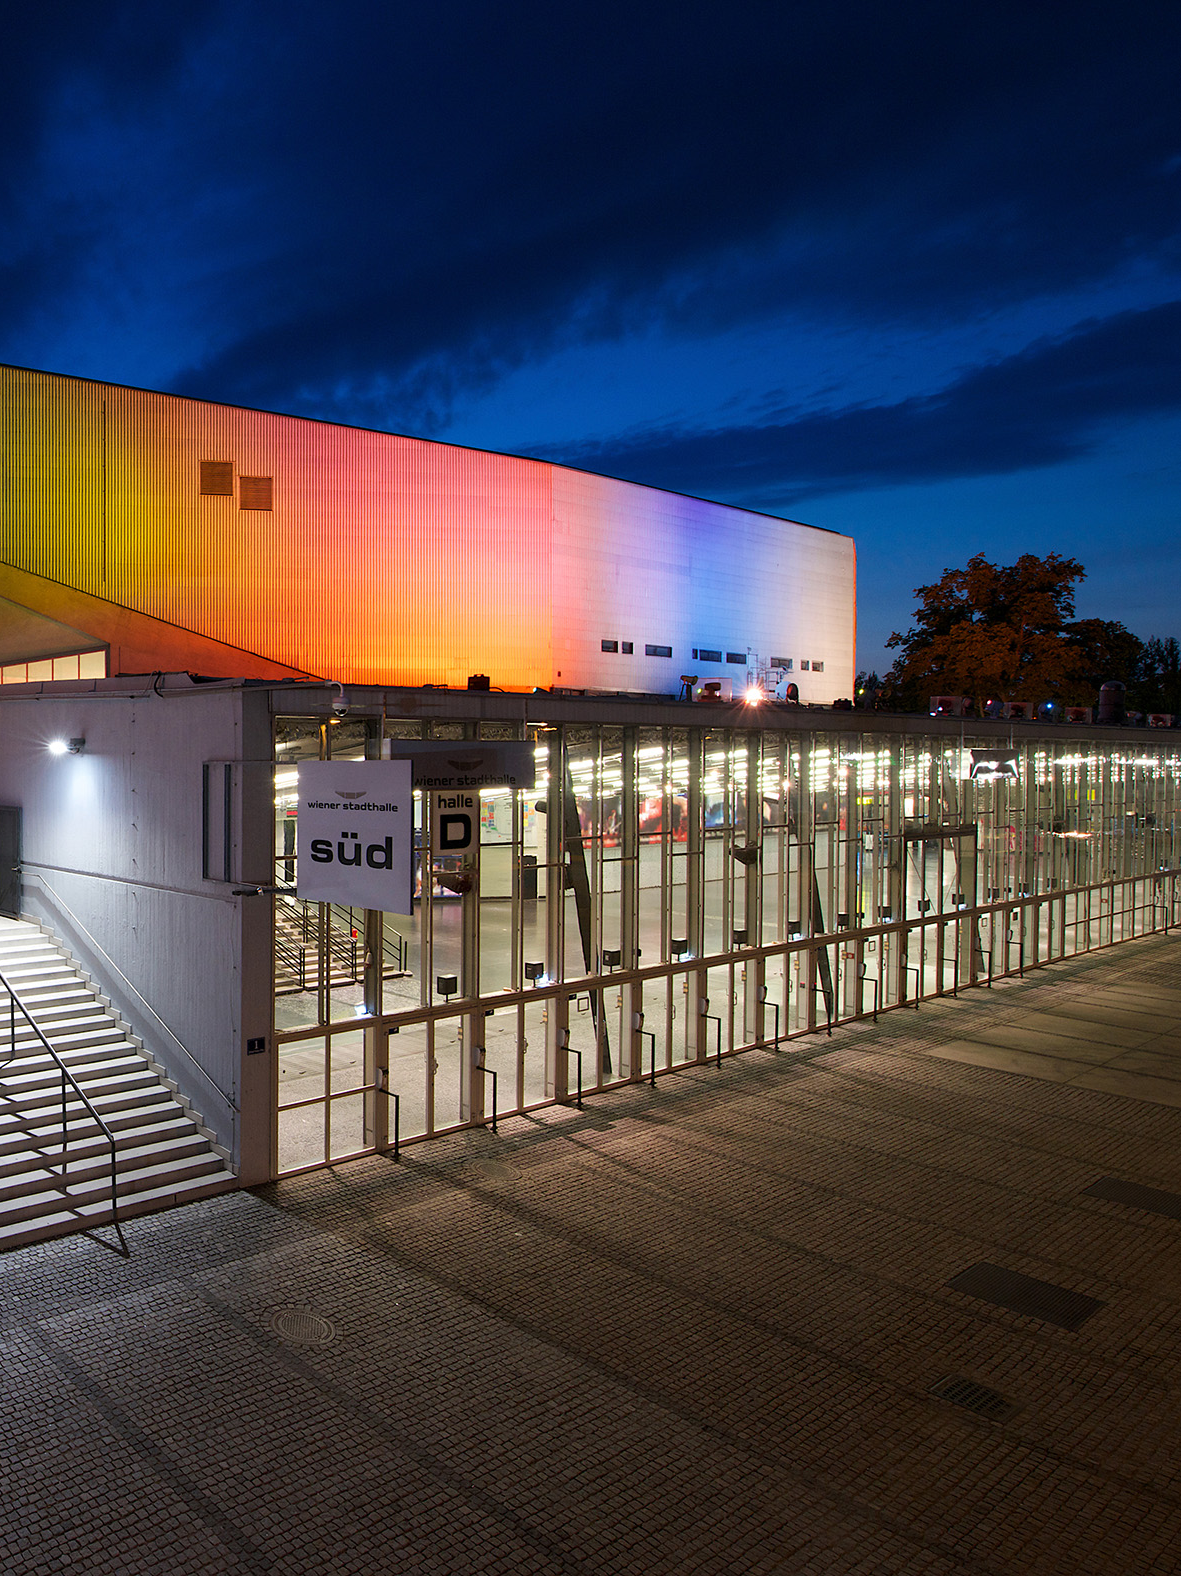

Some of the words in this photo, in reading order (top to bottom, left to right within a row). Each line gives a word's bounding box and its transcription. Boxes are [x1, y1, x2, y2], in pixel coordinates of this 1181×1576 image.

[414, 775, 454, 786] wiener
[457, 774, 516, 786] stadthalle
[307, 800, 341, 810] wiener
[342, 802, 398, 813] stadthalle
[437, 794, 473, 809] halle
[439, 813, 472, 850] D
[310, 831, 393, 870] süd
